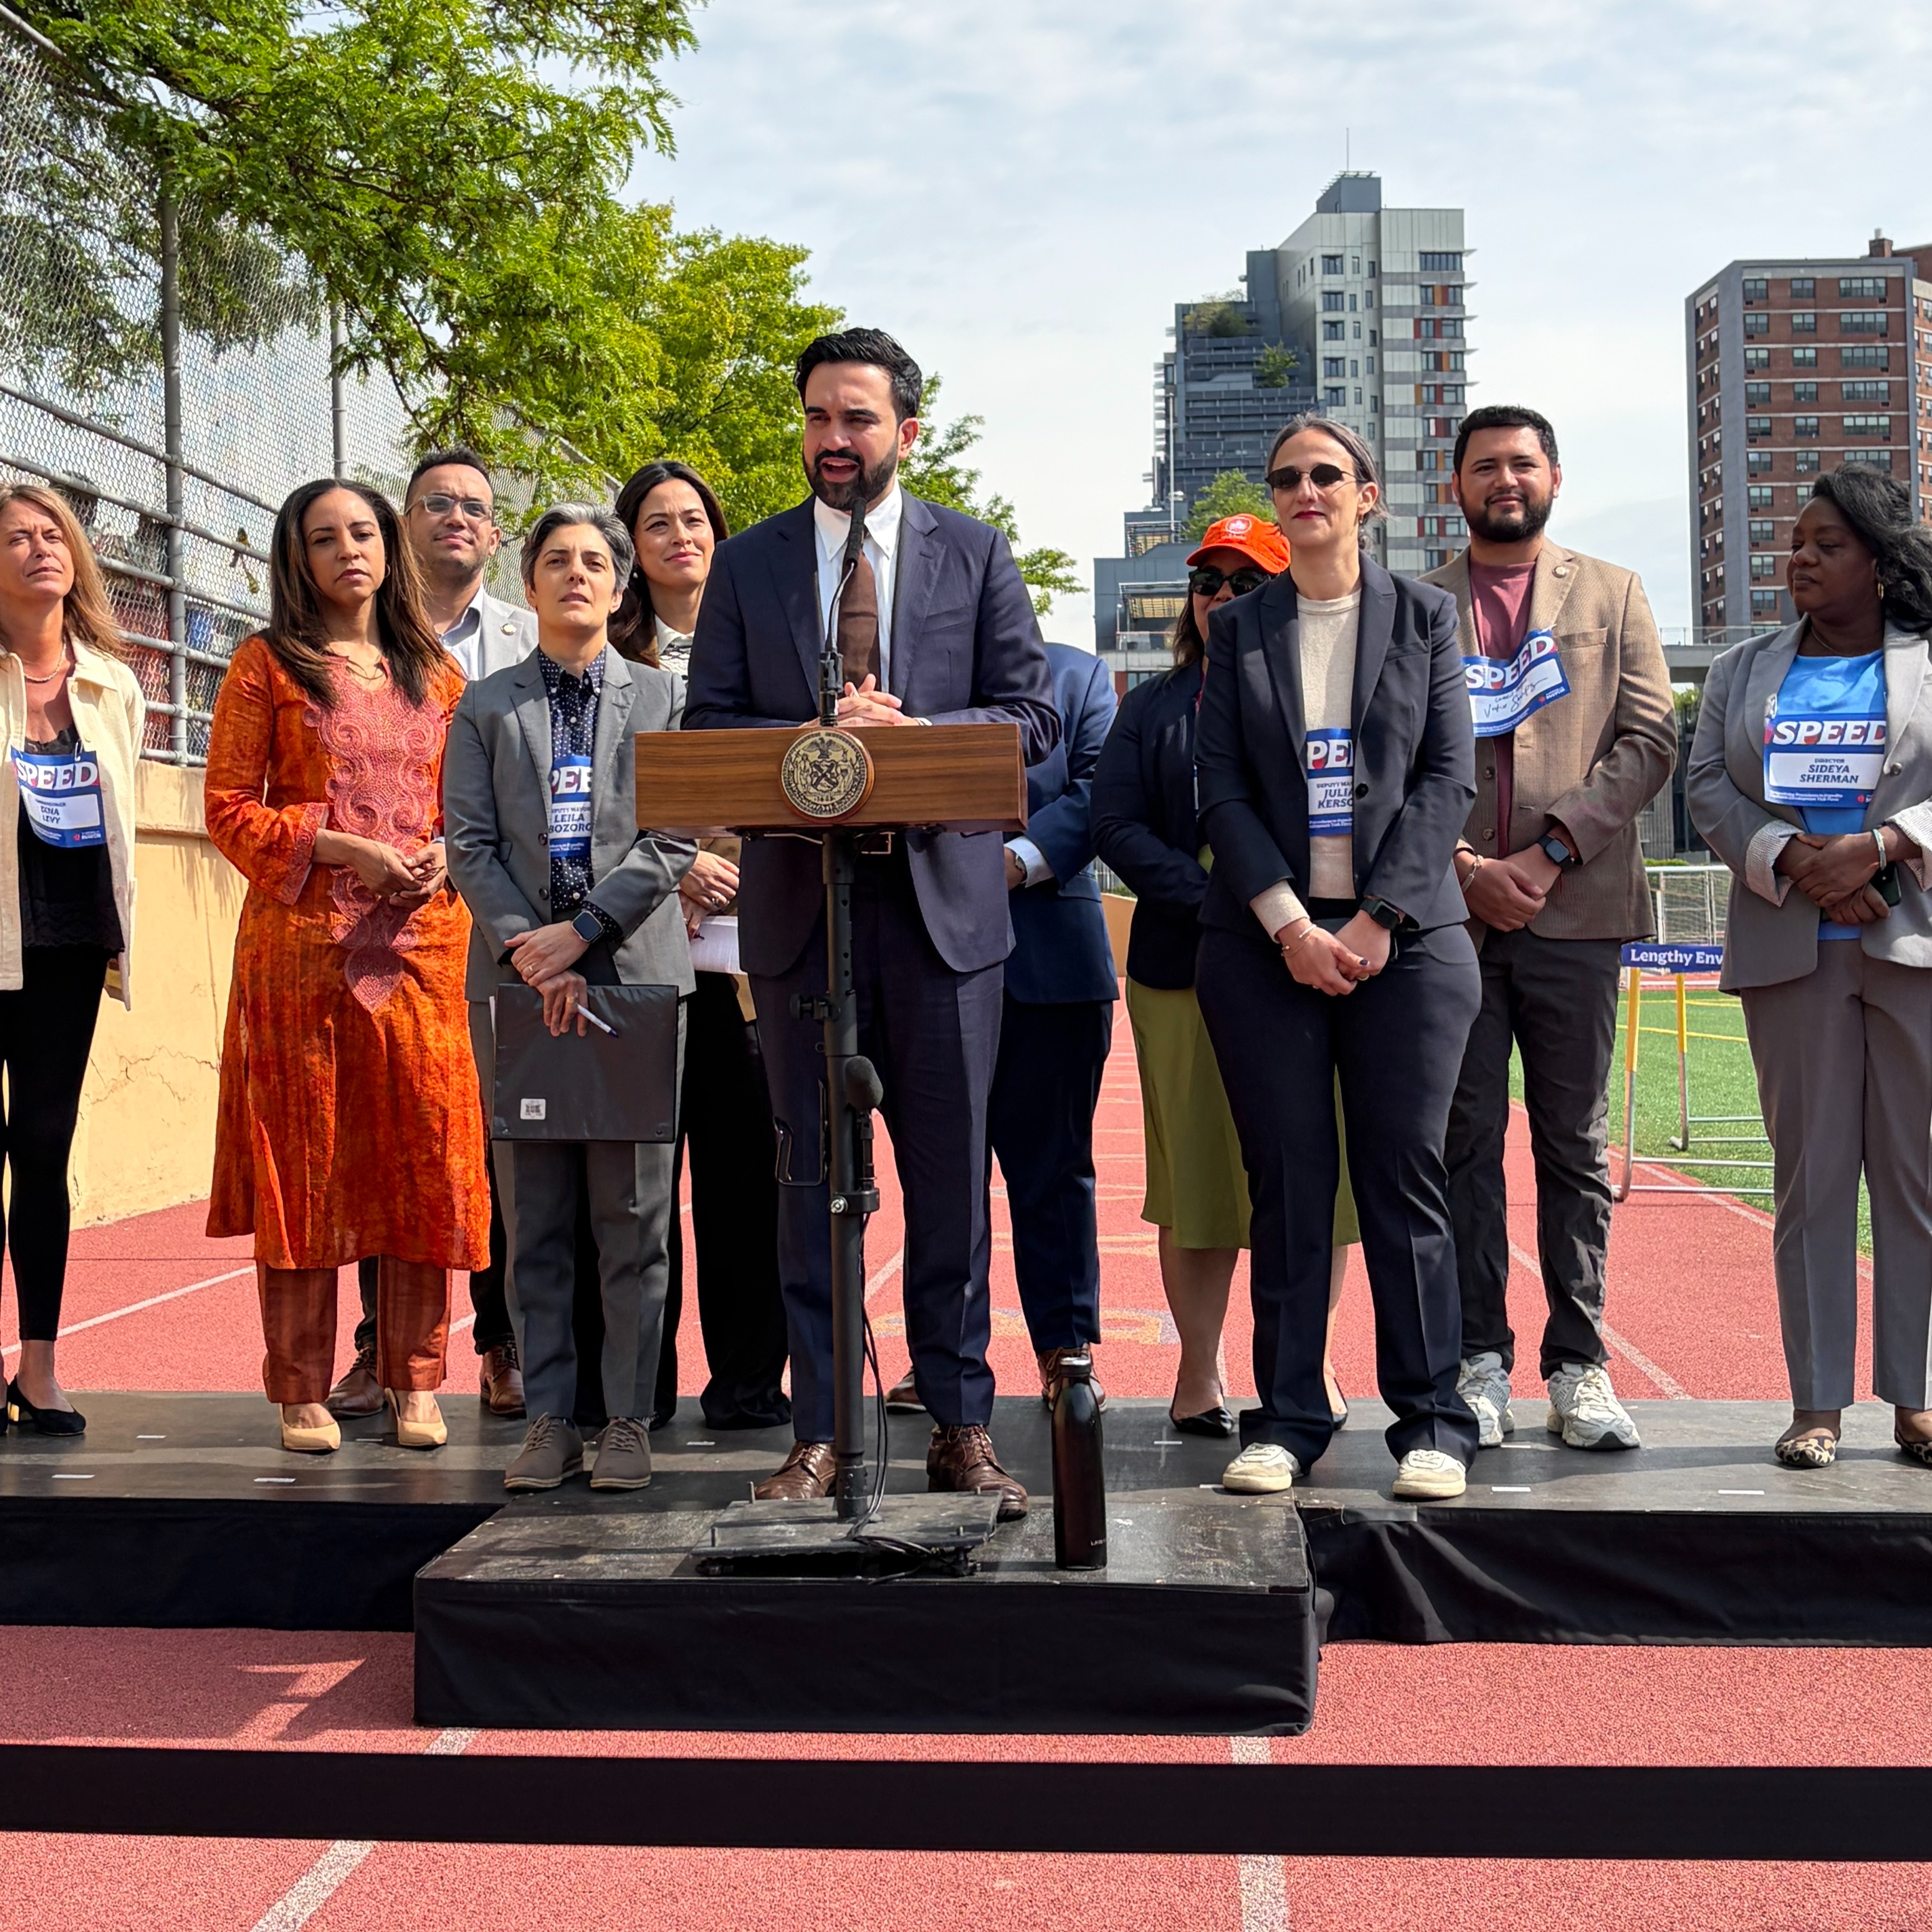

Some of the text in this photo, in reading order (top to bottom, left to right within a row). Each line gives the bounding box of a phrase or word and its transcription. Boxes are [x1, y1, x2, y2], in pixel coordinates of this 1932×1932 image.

[1466, 636, 1554, 689] SPEED
[1773, 721, 1886, 745] SPEED
[1307, 739, 1352, 769] PE
[15, 758, 98, 790] SPEED
[1808, 764, 1850, 773] SIDEYA
[1799, 774, 1859, 784] SHERMAN
[554, 813, 584, 823] LEILA
[1631, 949, 1693, 966] Lengthy
